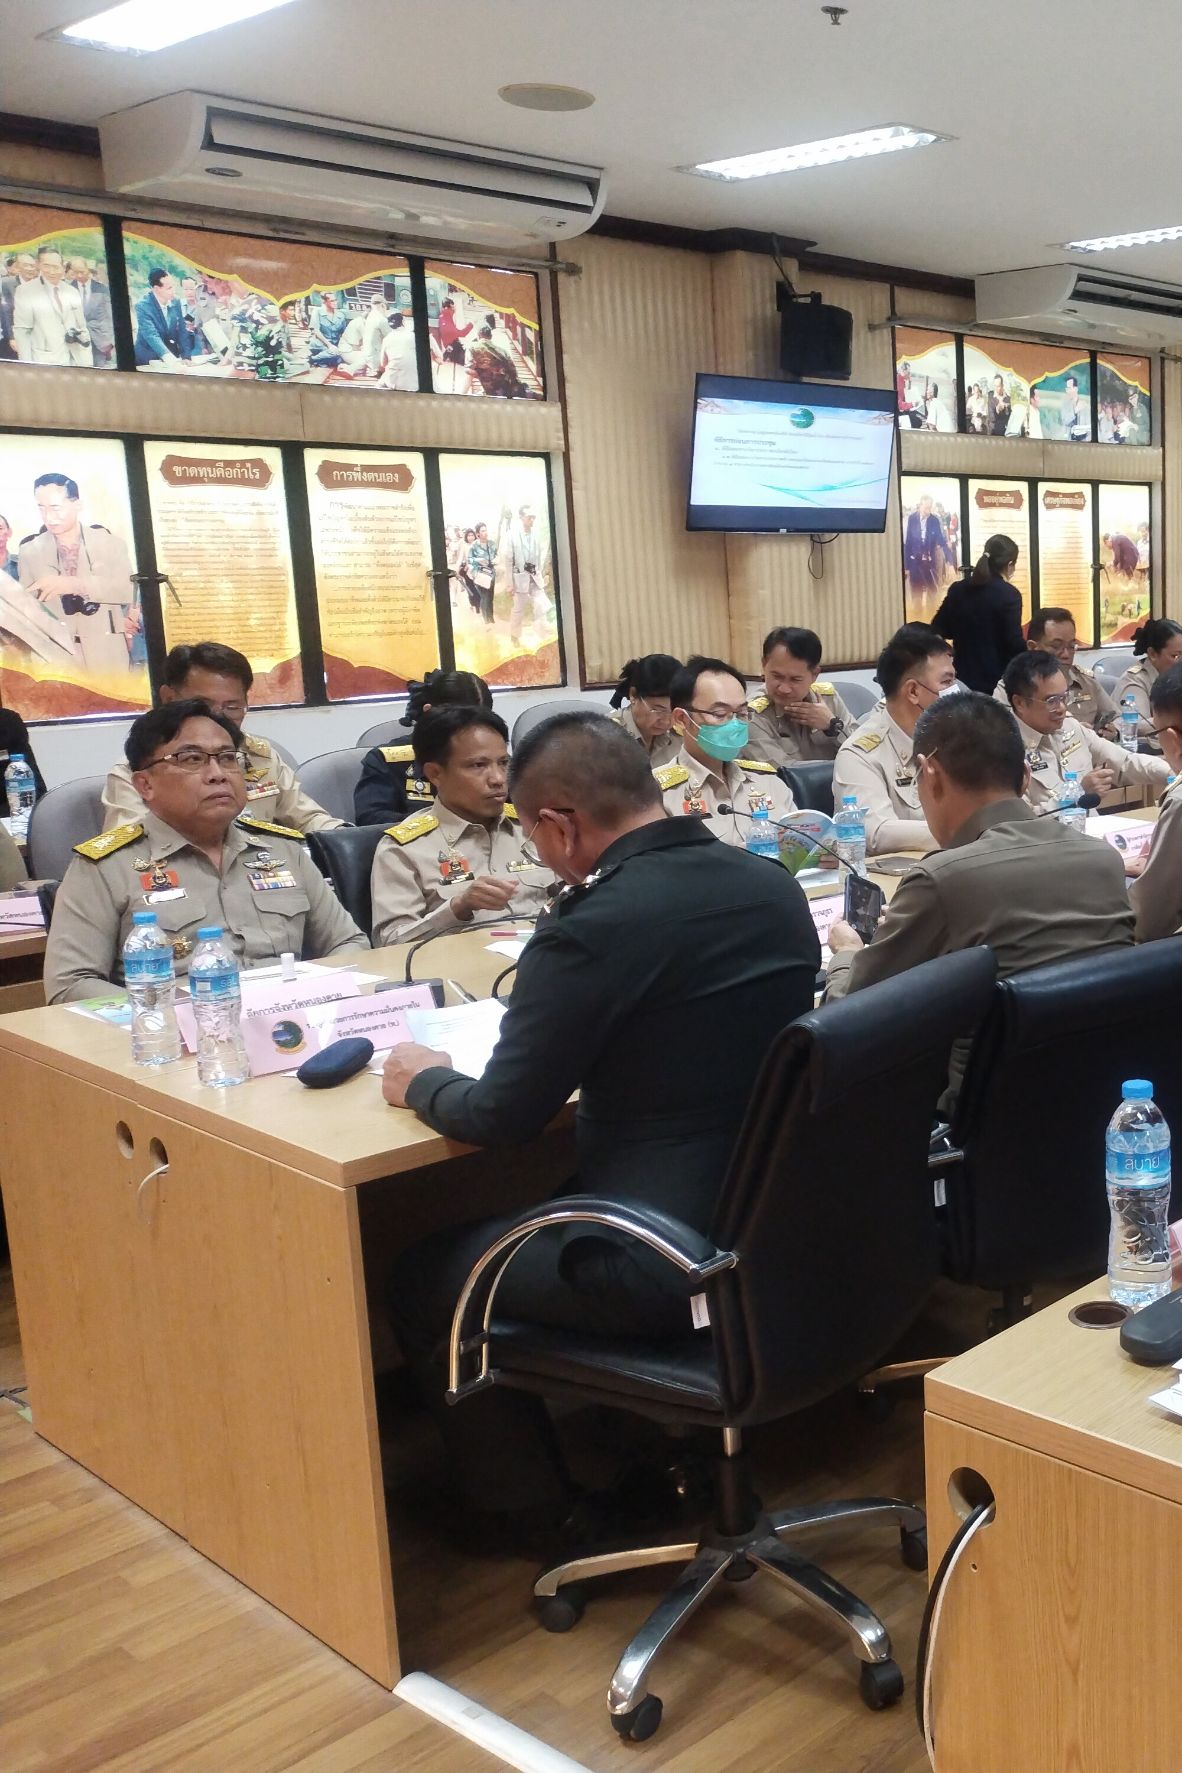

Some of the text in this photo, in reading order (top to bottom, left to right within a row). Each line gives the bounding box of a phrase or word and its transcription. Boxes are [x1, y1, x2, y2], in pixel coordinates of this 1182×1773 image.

[172, 461, 260, 483] ขาดทุนคือกำไร
[332, 463, 399, 483] การพึ่งตนเอง
[1125, 1156, 1160, 1171] สบาย
